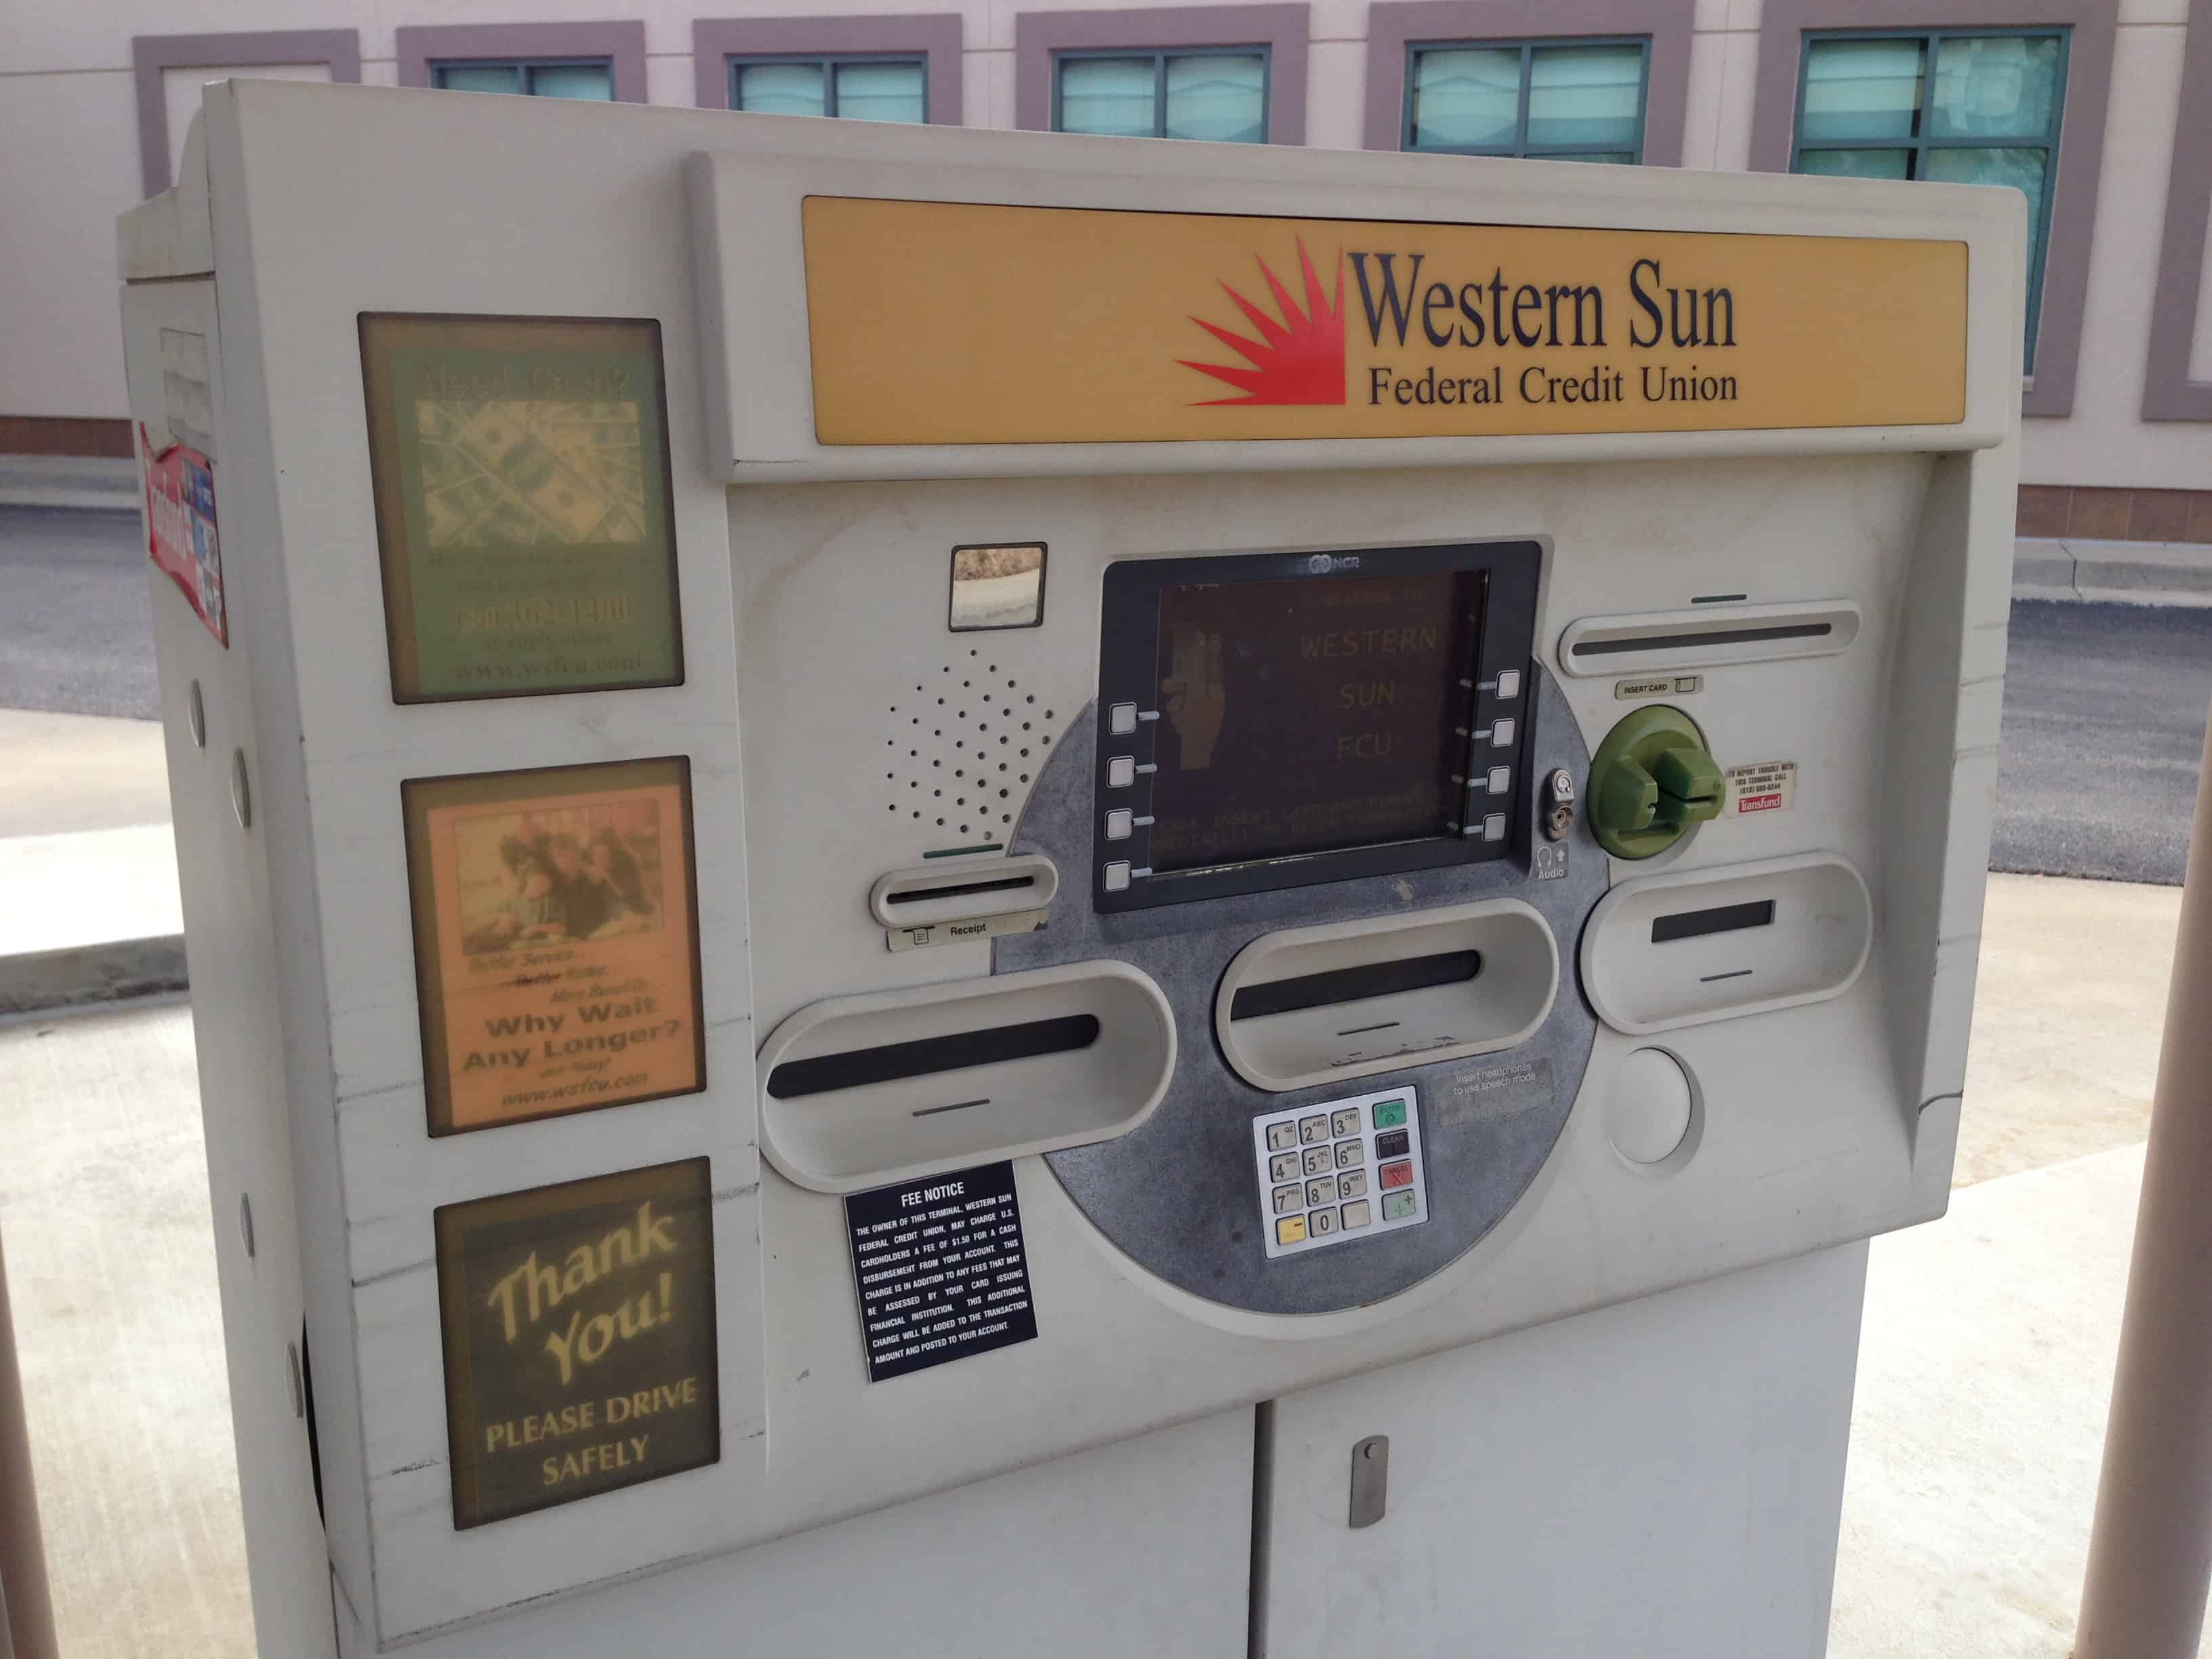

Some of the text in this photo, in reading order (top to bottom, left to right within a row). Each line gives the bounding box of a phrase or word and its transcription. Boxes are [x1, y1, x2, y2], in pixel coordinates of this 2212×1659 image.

[1347, 252, 1738, 348] Western Sun
[1368, 365, 1738, 405] Federal Credit Union
[1333, 556, 1360, 569] NCR
[1300, 626, 1436, 661] WESTERN
[1338, 679, 1395, 709] SUN
[1624, 683, 1668, 694] INSERT CARD
[1336, 731, 1391, 760] FCU
[1741, 796, 1779, 811] Transfund
[1537, 866, 1565, 880] Audio
[949, 923, 987, 937] Receipt
[484, 996, 660, 1039] Why Wait
[462, 1019, 680, 1073] Any Longer?
[1454, 1072, 1536, 1095] to use speech mode
[1456, 1063, 1532, 1084] Insert headphones
[1305, 1126, 1313, 1141] 2
[1312, 1120, 1326, 1128] ABC
[1336, 1120, 1345, 1134] 3
[1272, 1133, 1279, 1147] 1
[1276, 1164, 1285, 1179] 4
[1308, 1157, 1316, 1172] 5
[1340, 1151, 1348, 1165] 6
[901, 1182, 965, 1208] FEE NOTICE
[1277, 1195, 1286, 1210] 7
[1311, 1189, 1319, 1203] 8
[1343, 1181, 1351, 1195] 9
[857, 1194, 1012, 1237] THE OWNER OF THIS TERMINAL, WESTERN SUN
[1321, 1215, 1329, 1231] 0
[859, 1209, 1014, 1253] FEDERAL CREDIT UNION, MAY CHARGE U.S.
[861, 1250, 910, 1269] CARDHOLDERS
[914, 1248, 920, 1256] A
[923, 1244, 936, 1253] FEE
[939, 1240, 947, 1249] OF
[952, 1235, 970, 1248] $1.50
[973, 1232, 987, 1242] FOR
[999, 1224, 1017, 1235] CASH
[487, 1201, 678, 1345] Thank
[863, 1240, 1019, 1284] DISBURSEMENT FROM YOUR ACCOUNT. THIS
[865, 1254, 1020, 1300] CHARGE IS IN ADDITION TO ANY FEES THAT MAY
[867, 1269, 1023, 1316] BE ASSESSED BY YOUR CARD ISSUING
[870, 1285, 1025, 1332] FINANCIAL INSTITUTION. THIS ADDITIONAL
[544, 1271, 674, 1387] You!
[872, 1300, 1028, 1349] CHARGE WILL BE ADDED TO THE TRANSACTION
[875, 1322, 1009, 1364] AMOUNT AND POSTED TO YOUR ACCOUNT.
[486, 1376, 697, 1454] PLEASE DRIVE
[541, 1434, 649, 1486] SAFELY
